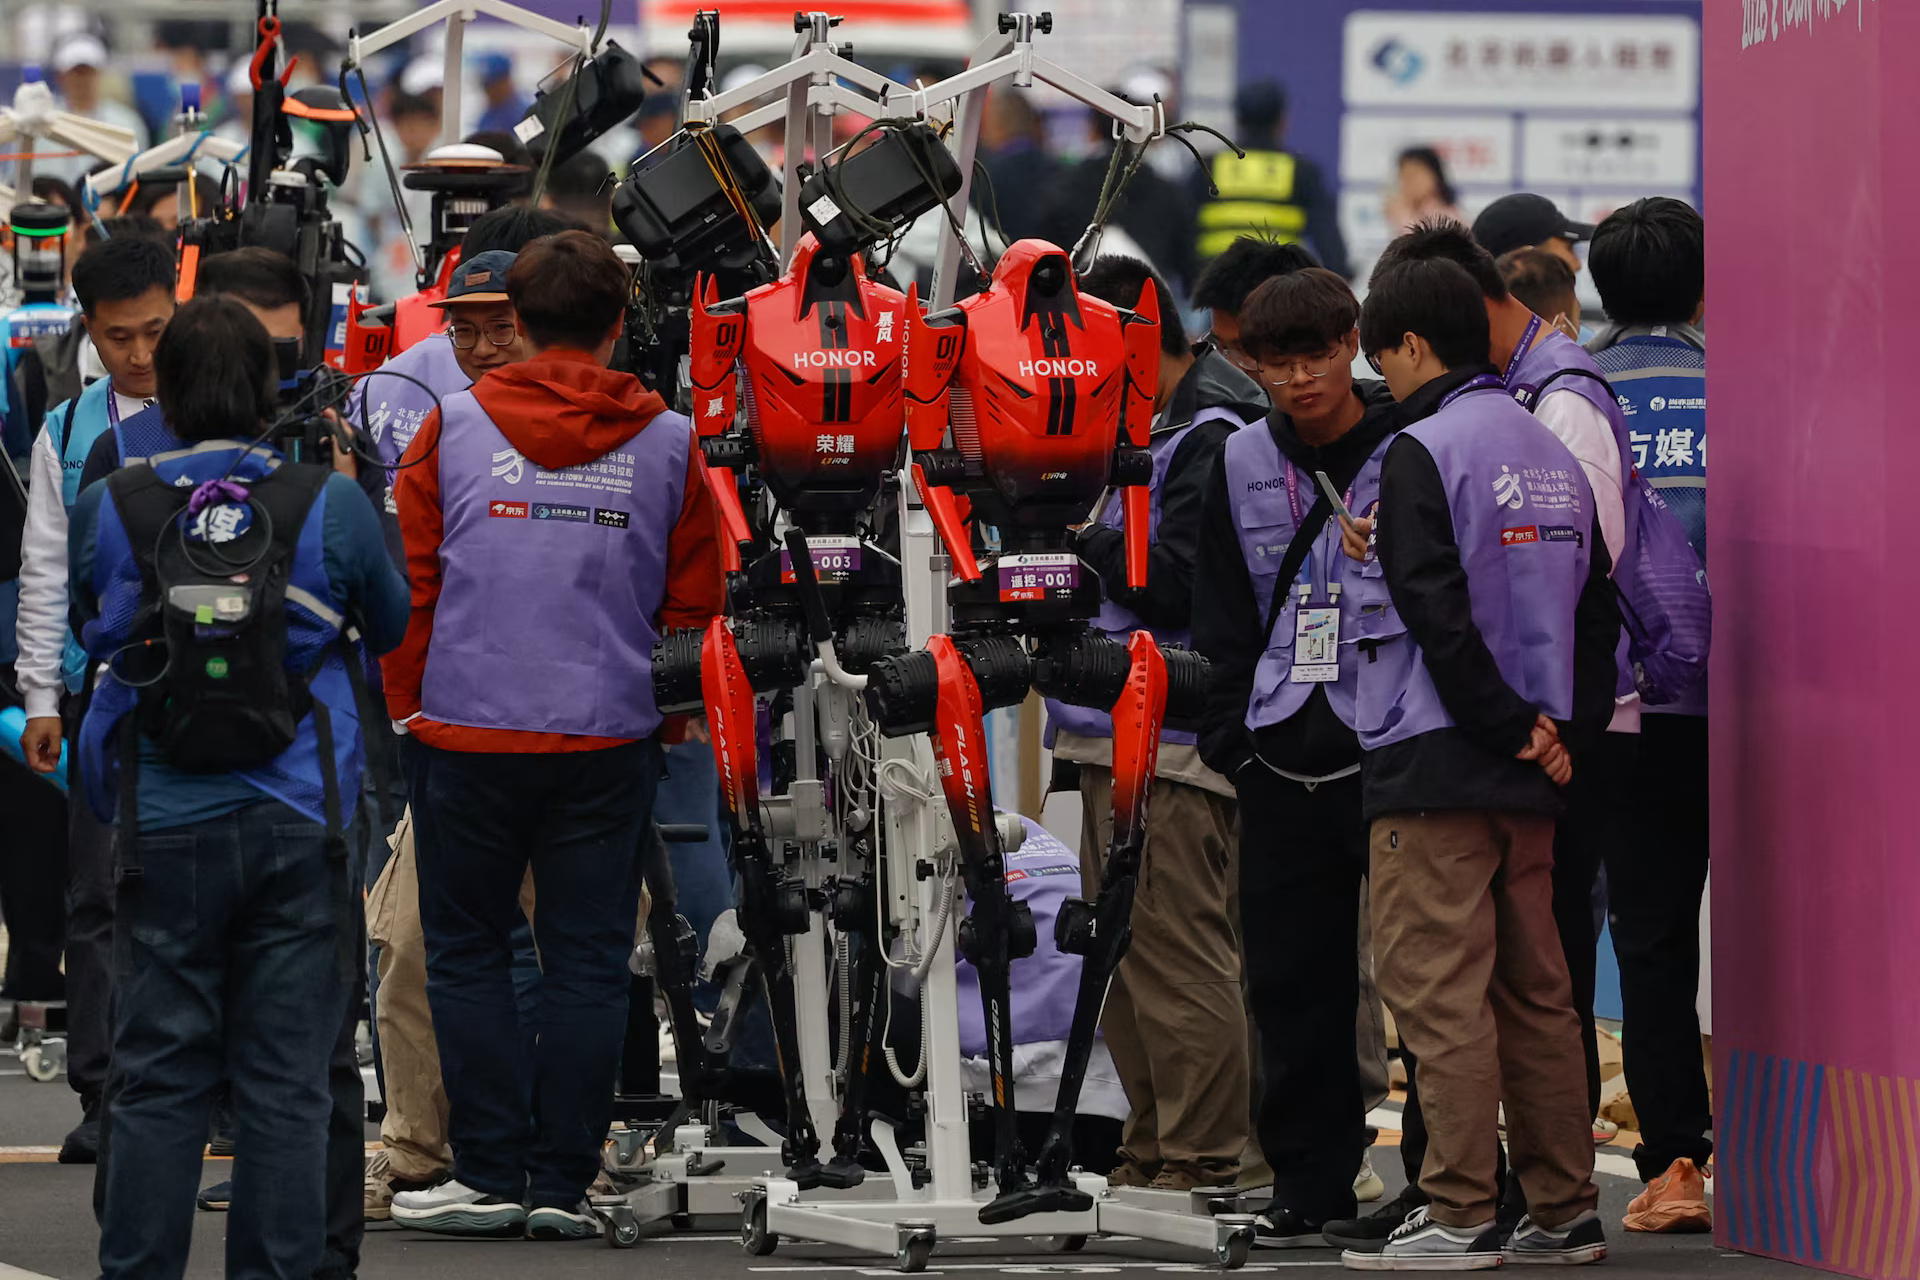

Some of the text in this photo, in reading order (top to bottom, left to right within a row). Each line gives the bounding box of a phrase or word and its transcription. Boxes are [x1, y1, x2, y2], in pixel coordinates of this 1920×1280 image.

[874, 311, 895, 344] 暴风
[902, 319, 911, 379] HONOR
[794, 350, 876, 368] HONOR
[1019, 360, 1098, 377] HONOR
[816, 434, 855, 453] 荣耀
[604, 452, 635, 465] 马拉松
[1247, 477, 1286, 492] HONOR
[505, 506, 525, 516] 京东
[191, 505, 244, 543] 媒
[1011, 573, 1072, 588] 遥控-001
[714, 706, 732, 779] FLASH
[954, 723, 975, 798] FLASH
[992, 999, 1002, 1075] SPEED
